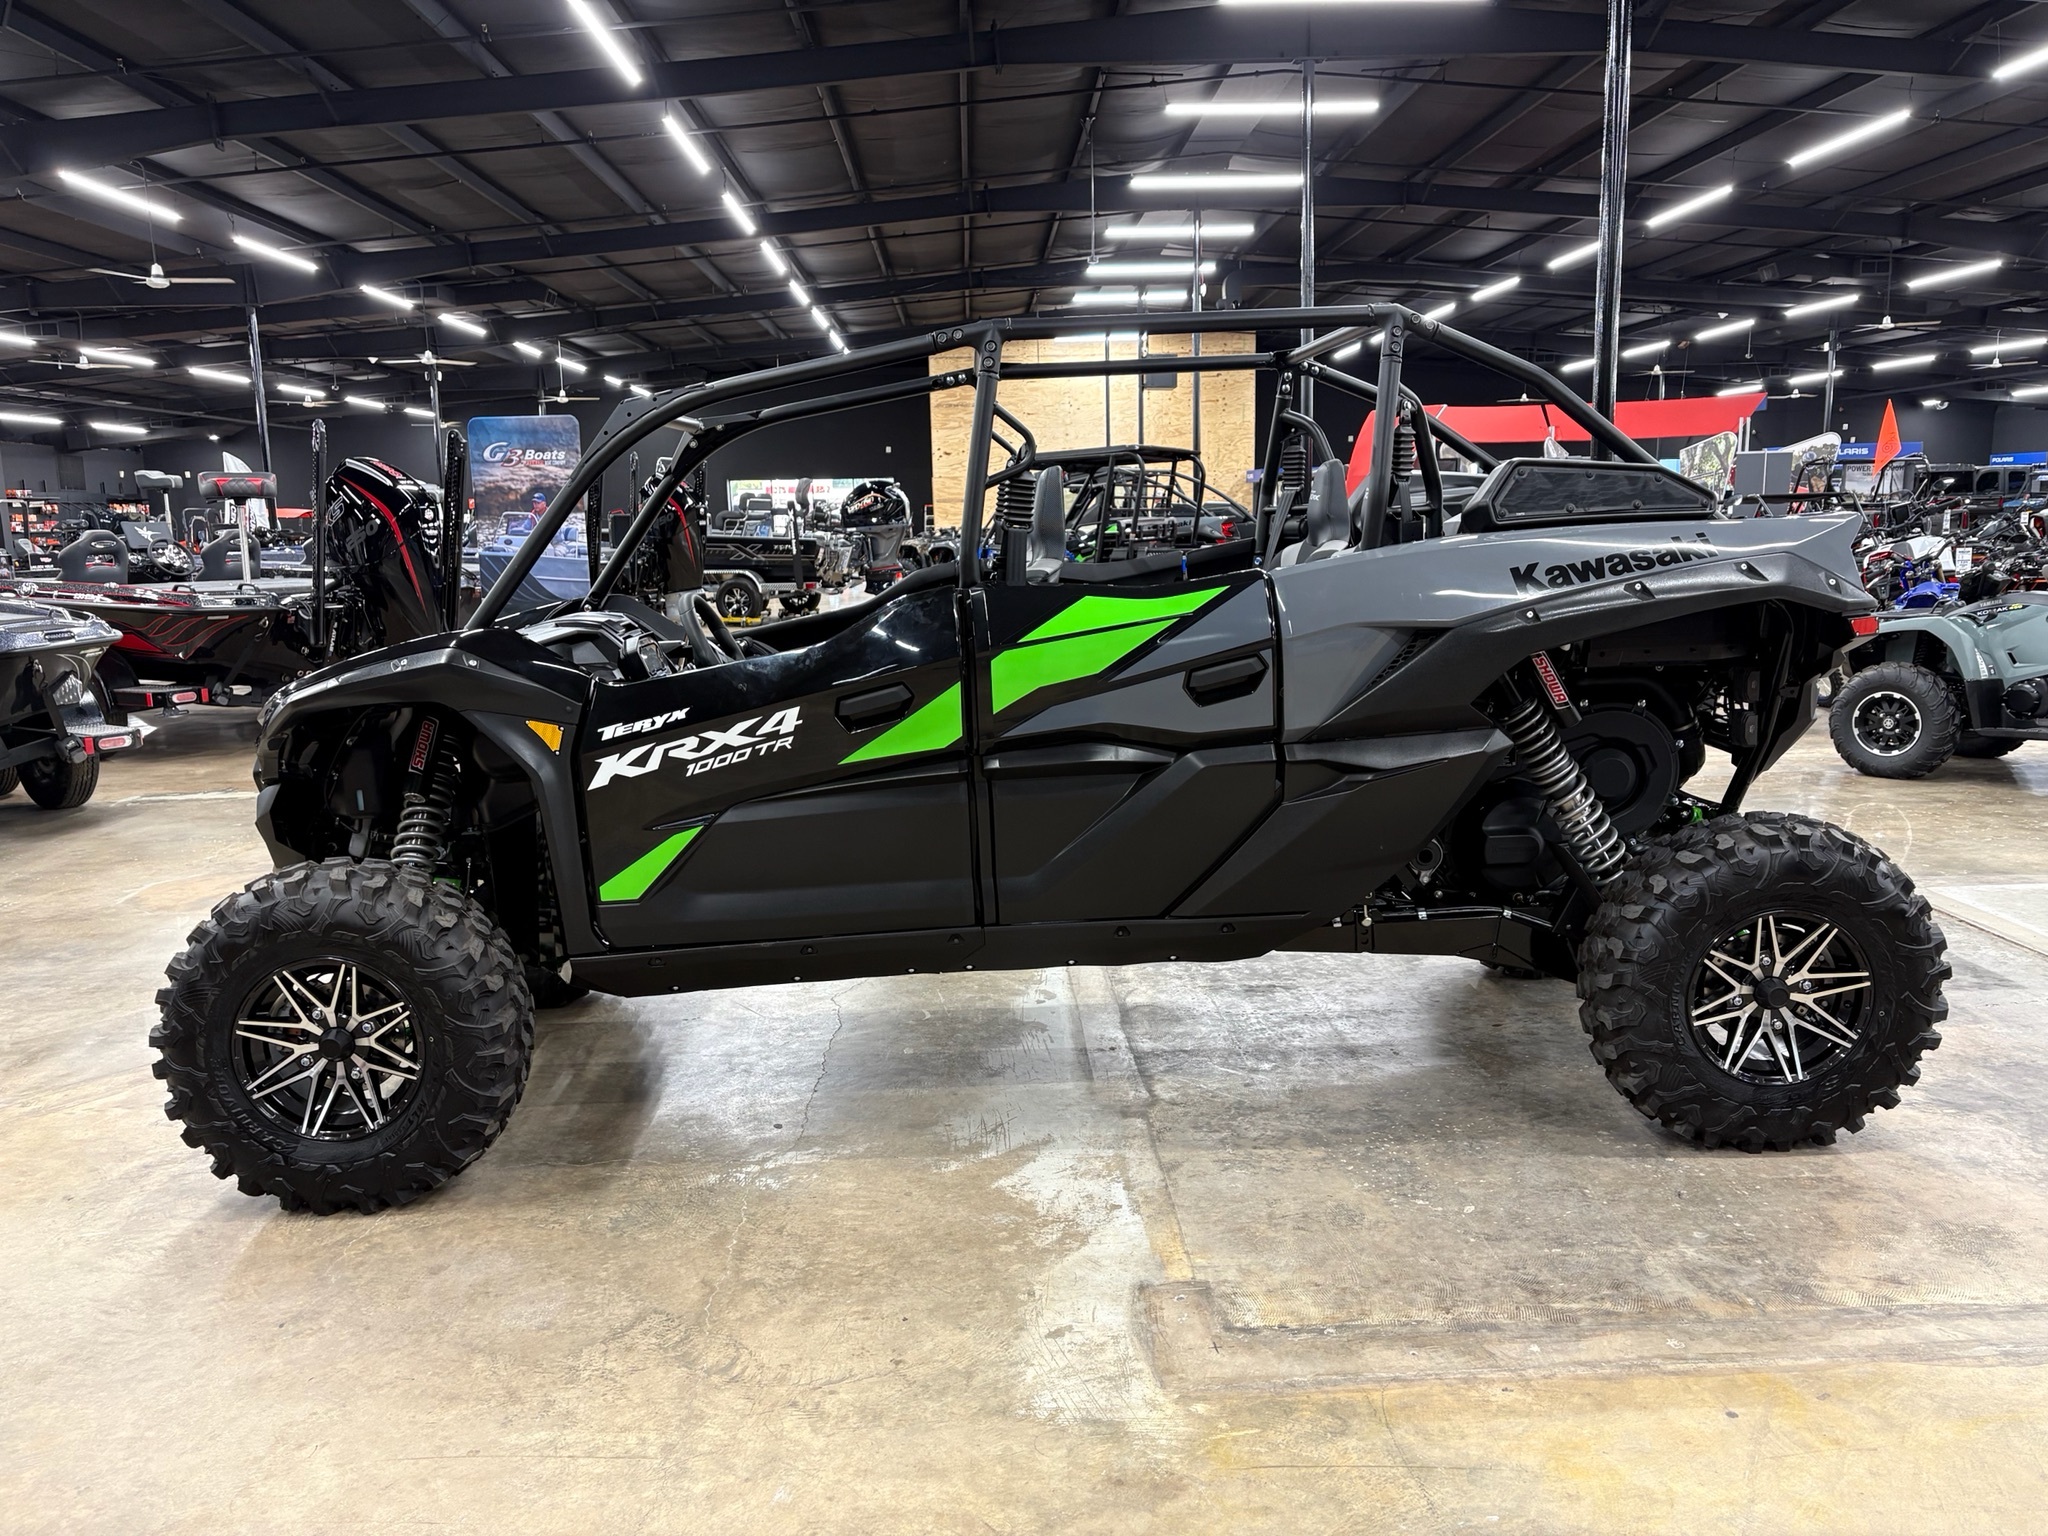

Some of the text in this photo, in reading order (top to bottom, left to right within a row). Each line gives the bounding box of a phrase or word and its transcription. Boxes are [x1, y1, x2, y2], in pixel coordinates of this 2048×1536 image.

[482, 441, 566, 468] G3 Boats
[1509, 531, 1719, 599] Kawasaki
[1980, 599, 2003, 608] YAMAHA
[1532, 655, 1569, 704] SHOWA
[411, 720, 435, 771] SHOWA
[587, 705, 804, 792] KRX4
[597, 707, 691, 741] TERYX
